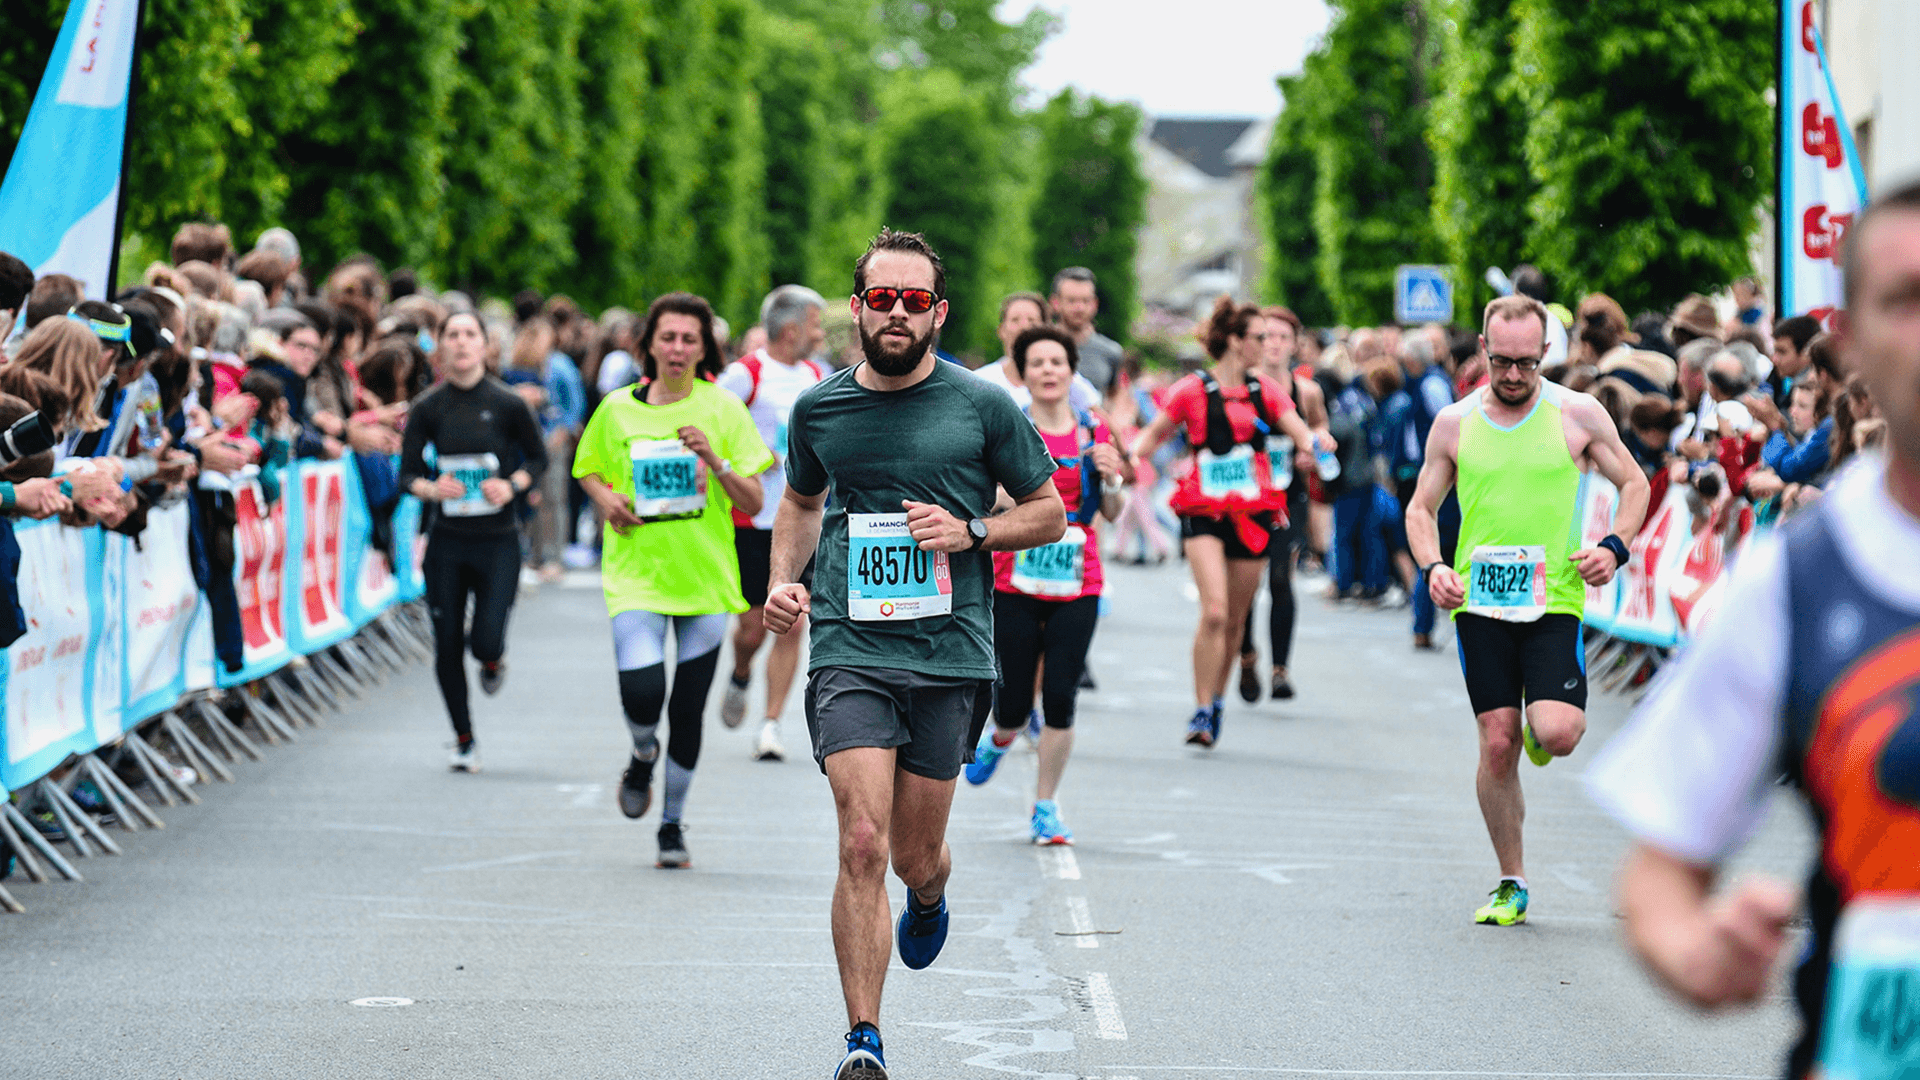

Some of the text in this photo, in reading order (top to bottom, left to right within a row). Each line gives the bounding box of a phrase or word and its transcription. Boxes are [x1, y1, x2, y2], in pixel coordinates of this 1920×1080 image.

[642, 461, 692, 491] 48591
[858, 546, 928, 586] 48570
[936, 550, 946, 564] 1h
[936, 564, 948, 580] 00
[1478, 564, 1528, 593] 48522
